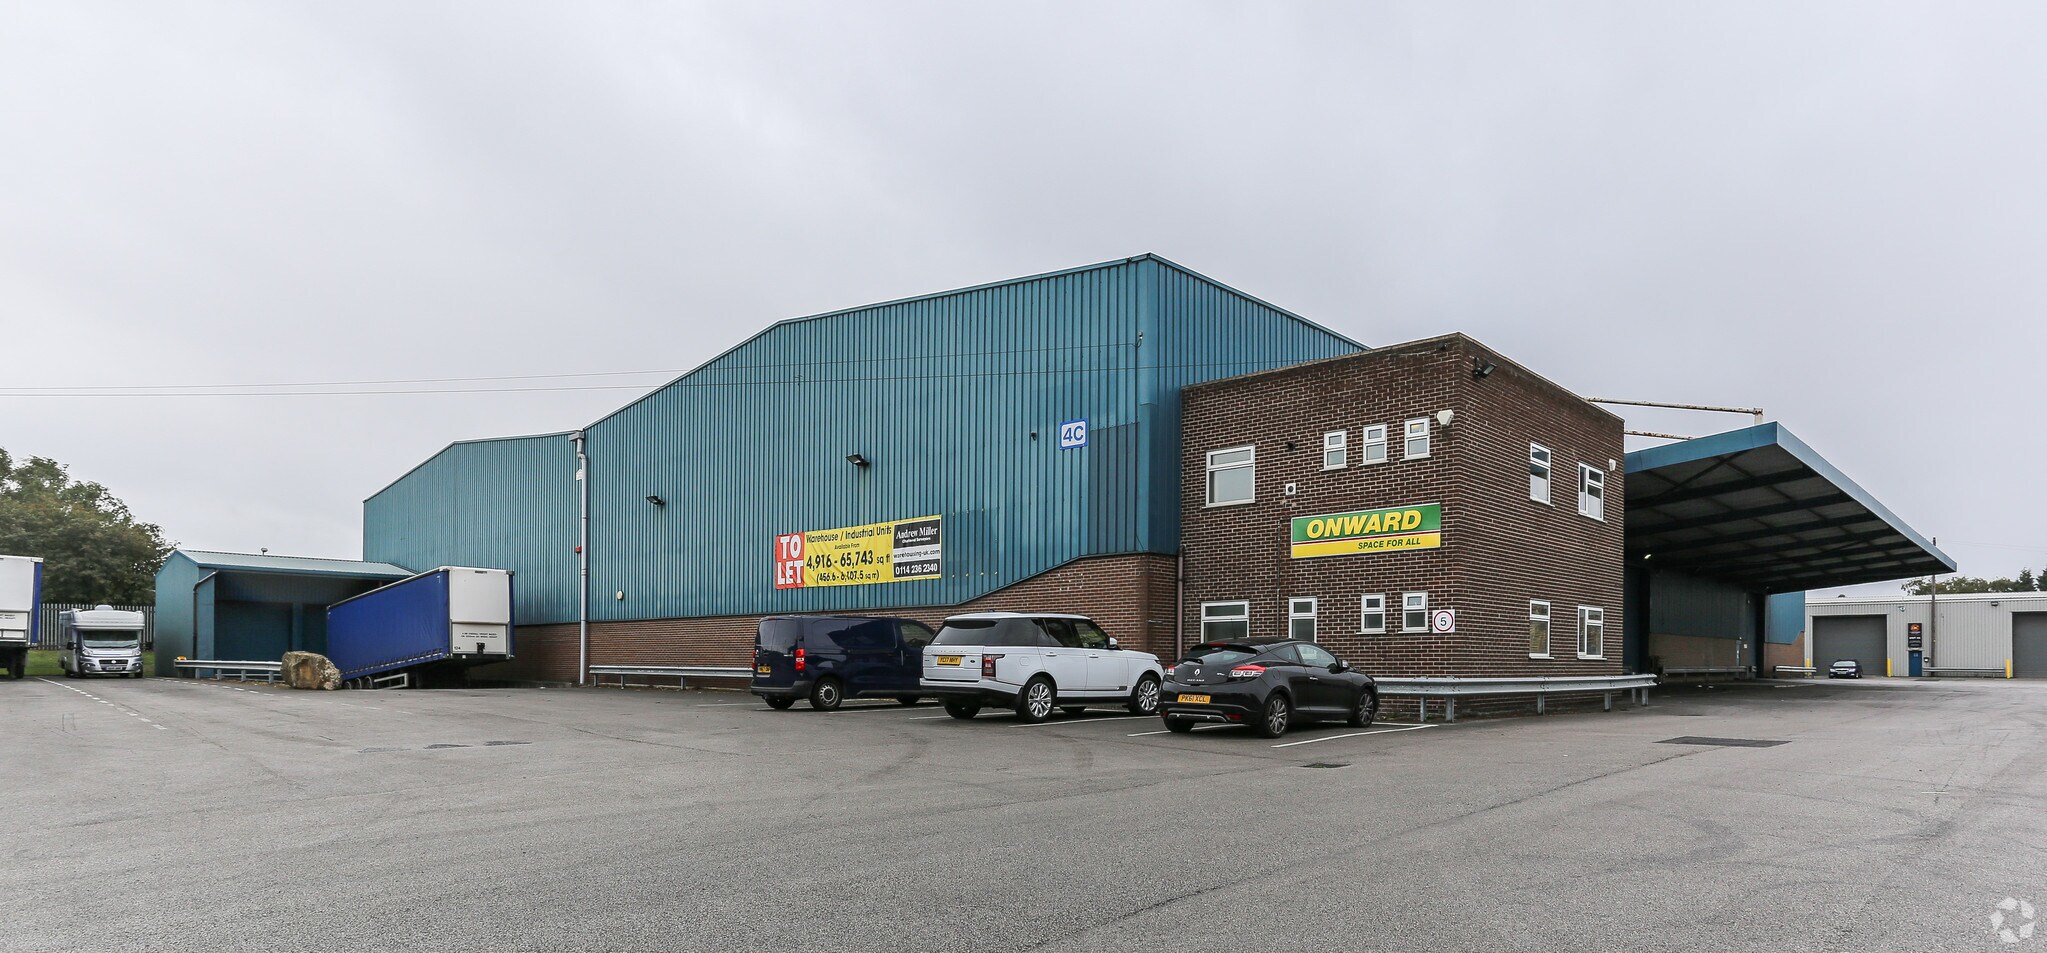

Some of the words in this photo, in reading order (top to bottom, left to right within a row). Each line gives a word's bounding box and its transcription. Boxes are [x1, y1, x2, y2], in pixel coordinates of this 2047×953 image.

[1062, 425, 1084, 442] 4C
[1306, 509, 1422, 539] ONWARD
[806, 533, 838, 544] Warehouse
[845, 528, 874, 540] Industrial
[876, 526, 892, 536] Units
[896, 529, 918, 539] Andrew
[919, 527, 938, 536] Miller
[780, 535, 801, 559] TO
[1358, 540, 1384, 550] SPACE
[1386, 539, 1404, 547] FOR
[1406, 537, 1421, 545] ALL
[806, 555, 832, 571] 4,916
[840, 550, 874, 569] 65,743
[876, 556, 884, 565] sq
[895, 566, 910, 575] 0114
[911, 564, 922, 574] 236
[923, 563, 937, 572] 2340
[777, 560, 804, 585] LET
[1440, 616, 1447, 626] 5
